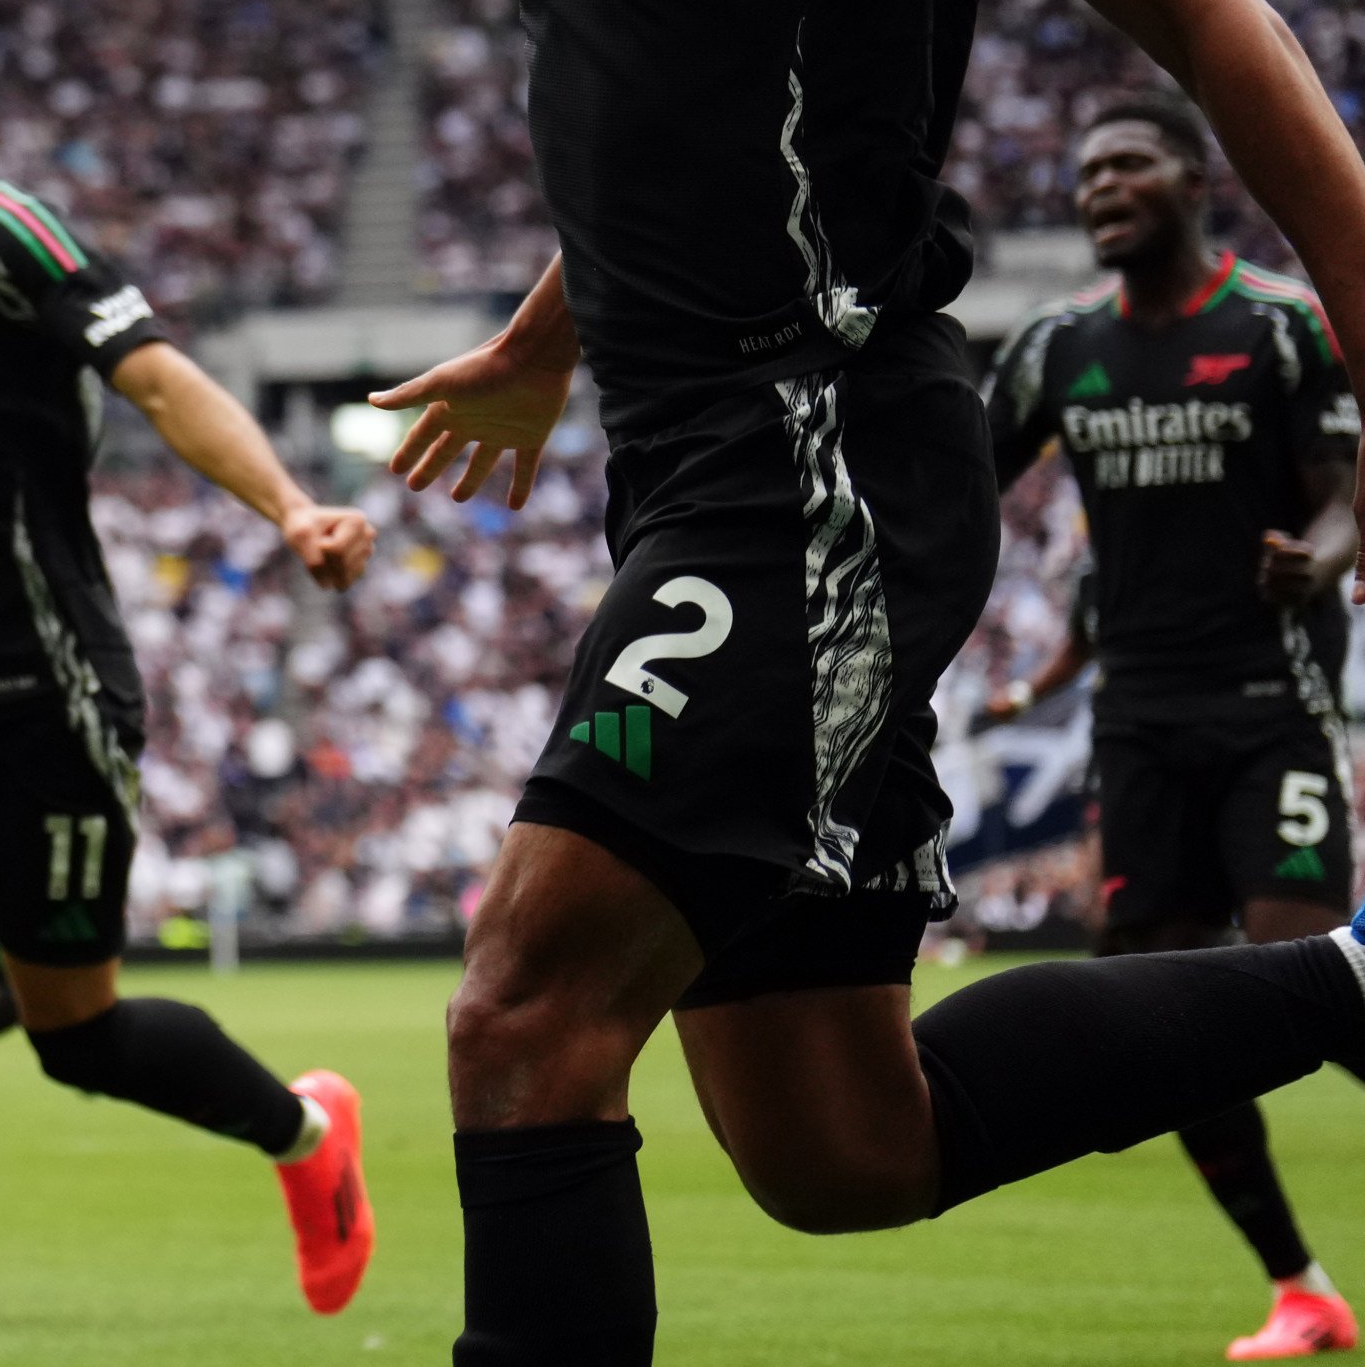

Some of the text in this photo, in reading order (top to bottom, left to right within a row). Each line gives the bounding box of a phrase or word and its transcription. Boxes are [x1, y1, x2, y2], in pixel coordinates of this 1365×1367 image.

[1062, 396, 1253, 453] Emirates
[604, 575, 734, 719] 2
[1276, 770, 1331, 847] 5
[43, 813, 108, 900] 11
